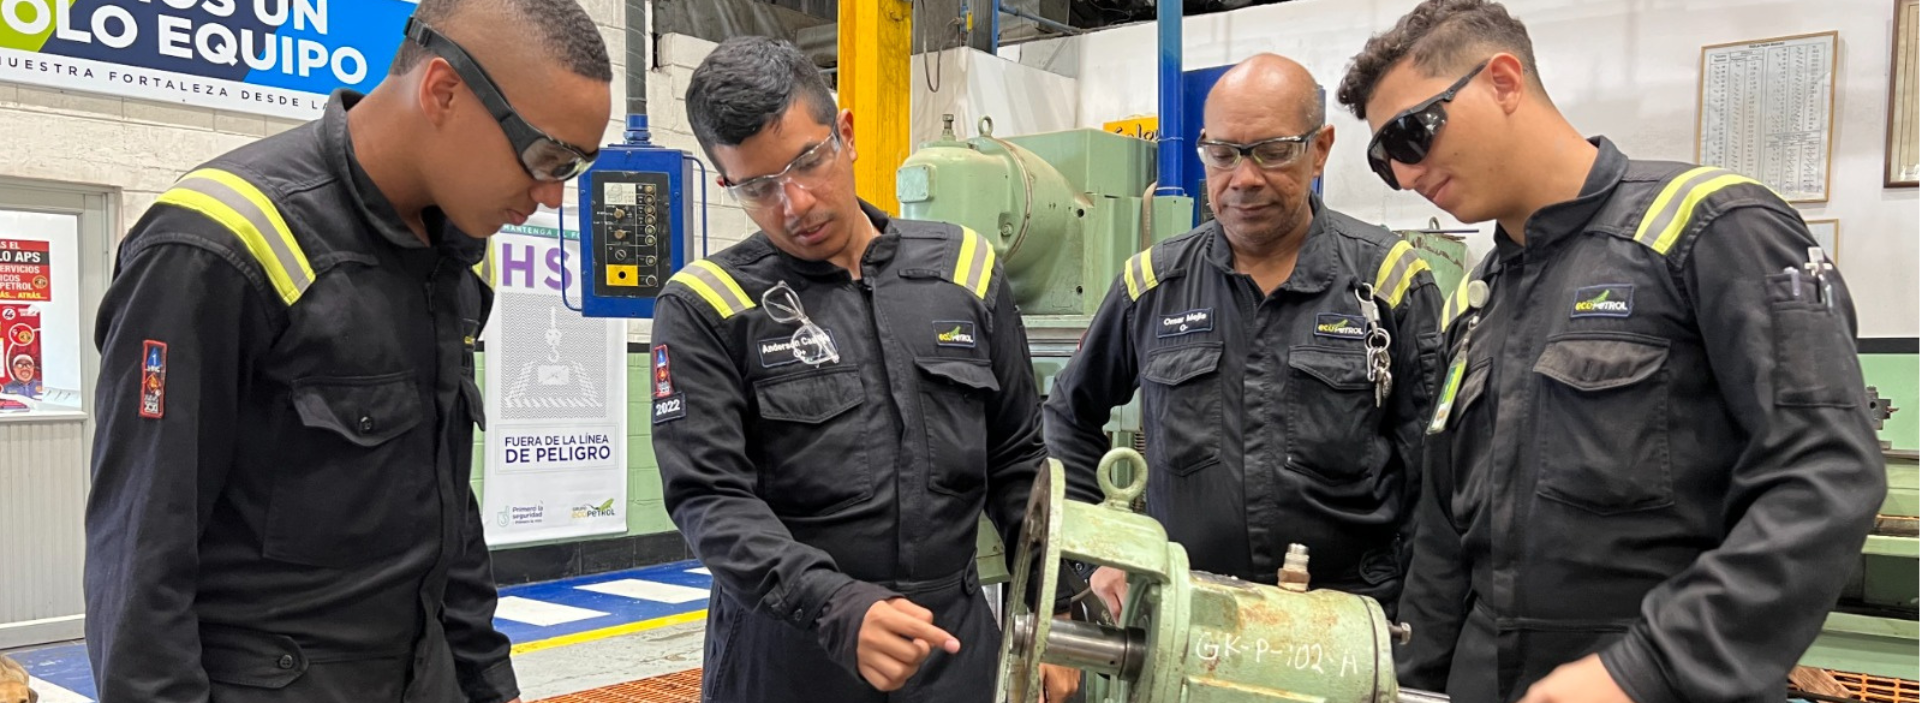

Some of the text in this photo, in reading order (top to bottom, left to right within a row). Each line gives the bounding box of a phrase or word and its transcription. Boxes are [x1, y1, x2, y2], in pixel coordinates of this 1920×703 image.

[252, 0, 328, 35] UN
[158, 14, 368, 84] EQUIPO
[0, 56, 94, 78] UESTRA
[109, 71, 229, 97] FORTALEZA
[241, 90, 300, 107] DESDE
[15, 251, 41, 263] APS
[655, 398, 680, 416] 2022
[505, 432, 609, 447] FUERA DE LA LÍNEA
[505, 445, 610, 464] DE PELIGRO
